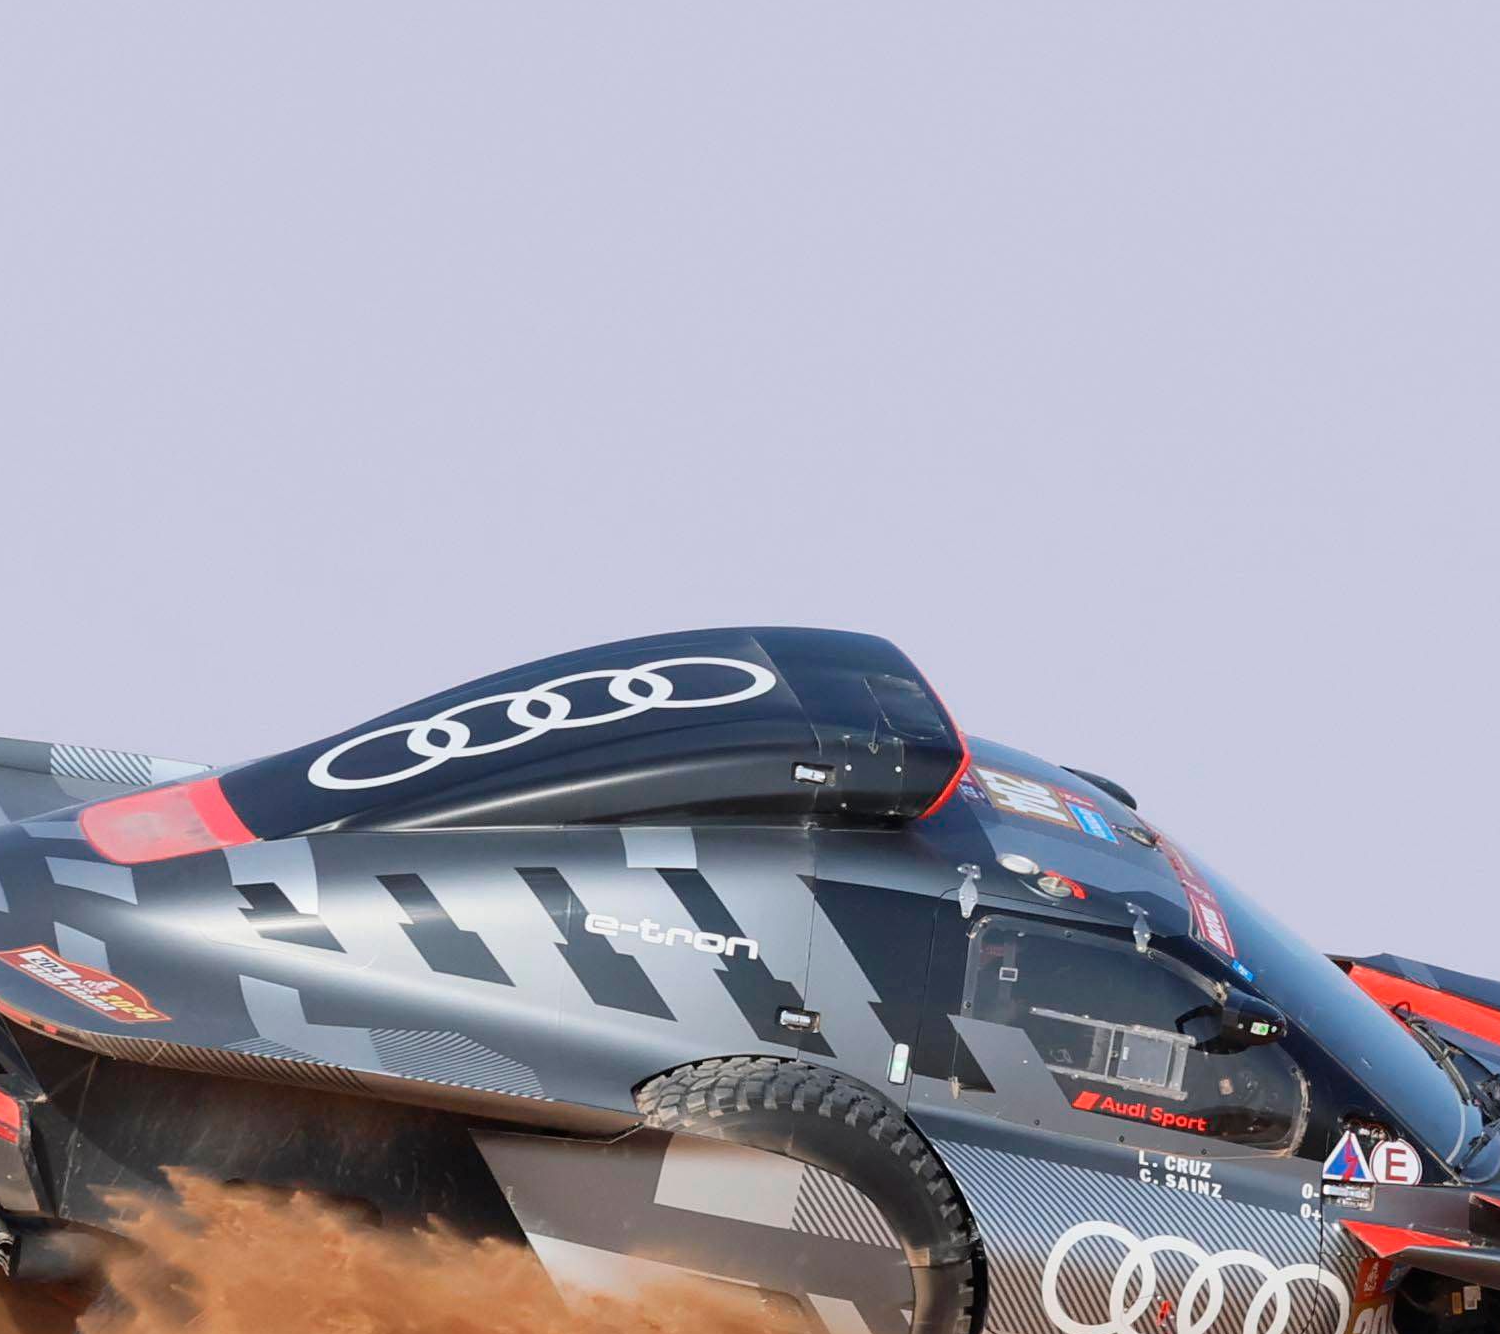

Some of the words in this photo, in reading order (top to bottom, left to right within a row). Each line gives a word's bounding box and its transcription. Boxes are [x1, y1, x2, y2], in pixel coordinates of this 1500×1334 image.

[584, 913, 759, 960] e-tron
[31, 956, 68, 974] 204
[1100, 1097, 1147, 1120] Audi
[1150, 1107, 1207, 1132] Sport
[1138, 1149, 1159, 1168] L.
[1164, 1155, 1212, 1179] CRUZ
[1385, 1148, 1408, 1182] E
[1139, 1168, 1159, 1185] C.
[1165, 1173, 1223, 1200] SAINZ
